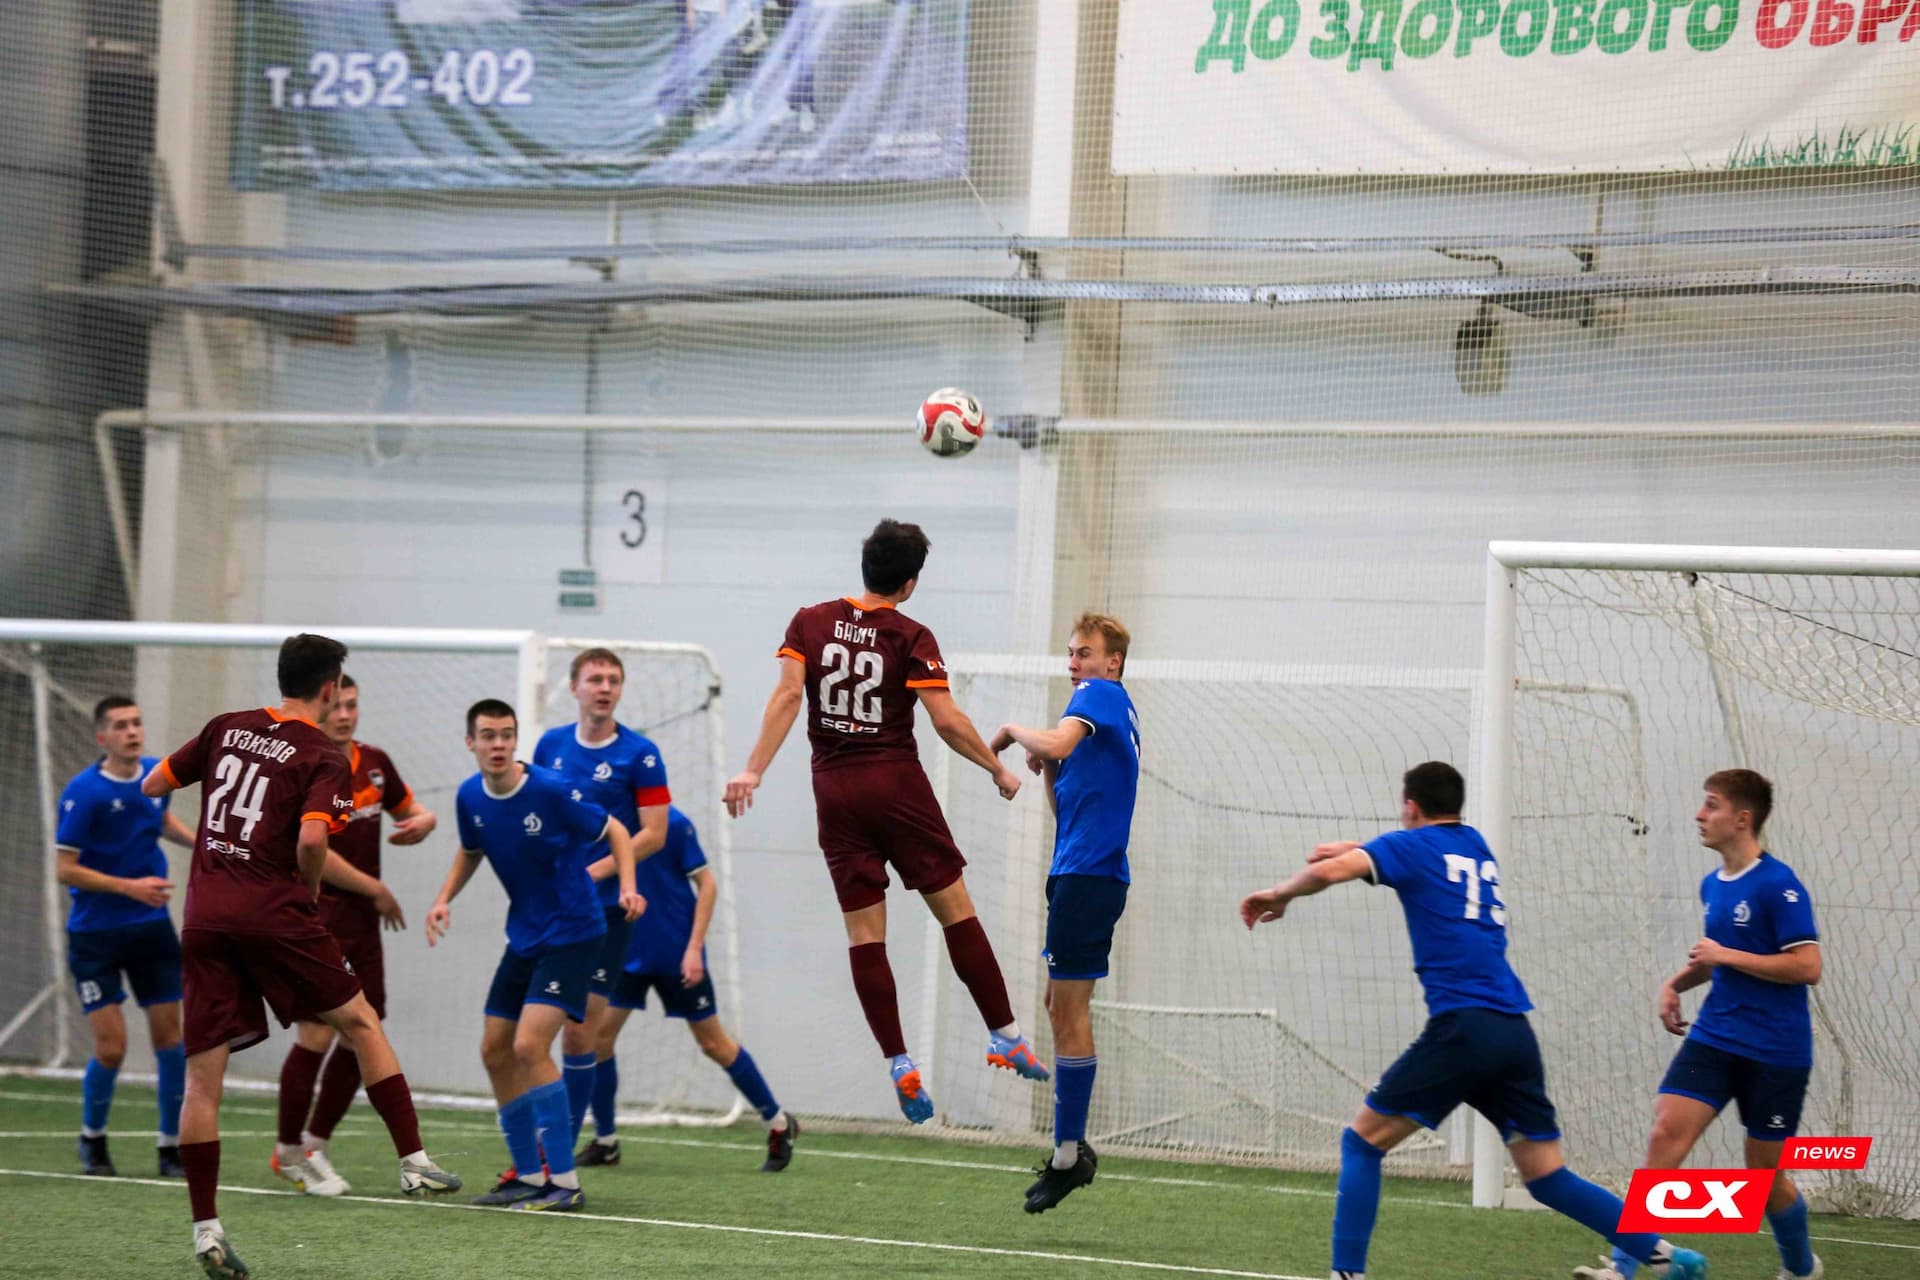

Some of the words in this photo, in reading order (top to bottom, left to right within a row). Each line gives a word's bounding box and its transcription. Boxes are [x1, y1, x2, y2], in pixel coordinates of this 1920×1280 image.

[1195, 0, 1303, 73] ДО
[1307, 0, 1742, 74] ЗДОРОВОГО
[619, 489, 648, 549] 3
[820, 642, 884, 724] 22
[221, 728, 297, 764] КУЗНЕЦОВ
[207, 753, 271, 842] 24
[1442, 853, 1506, 926] 73
